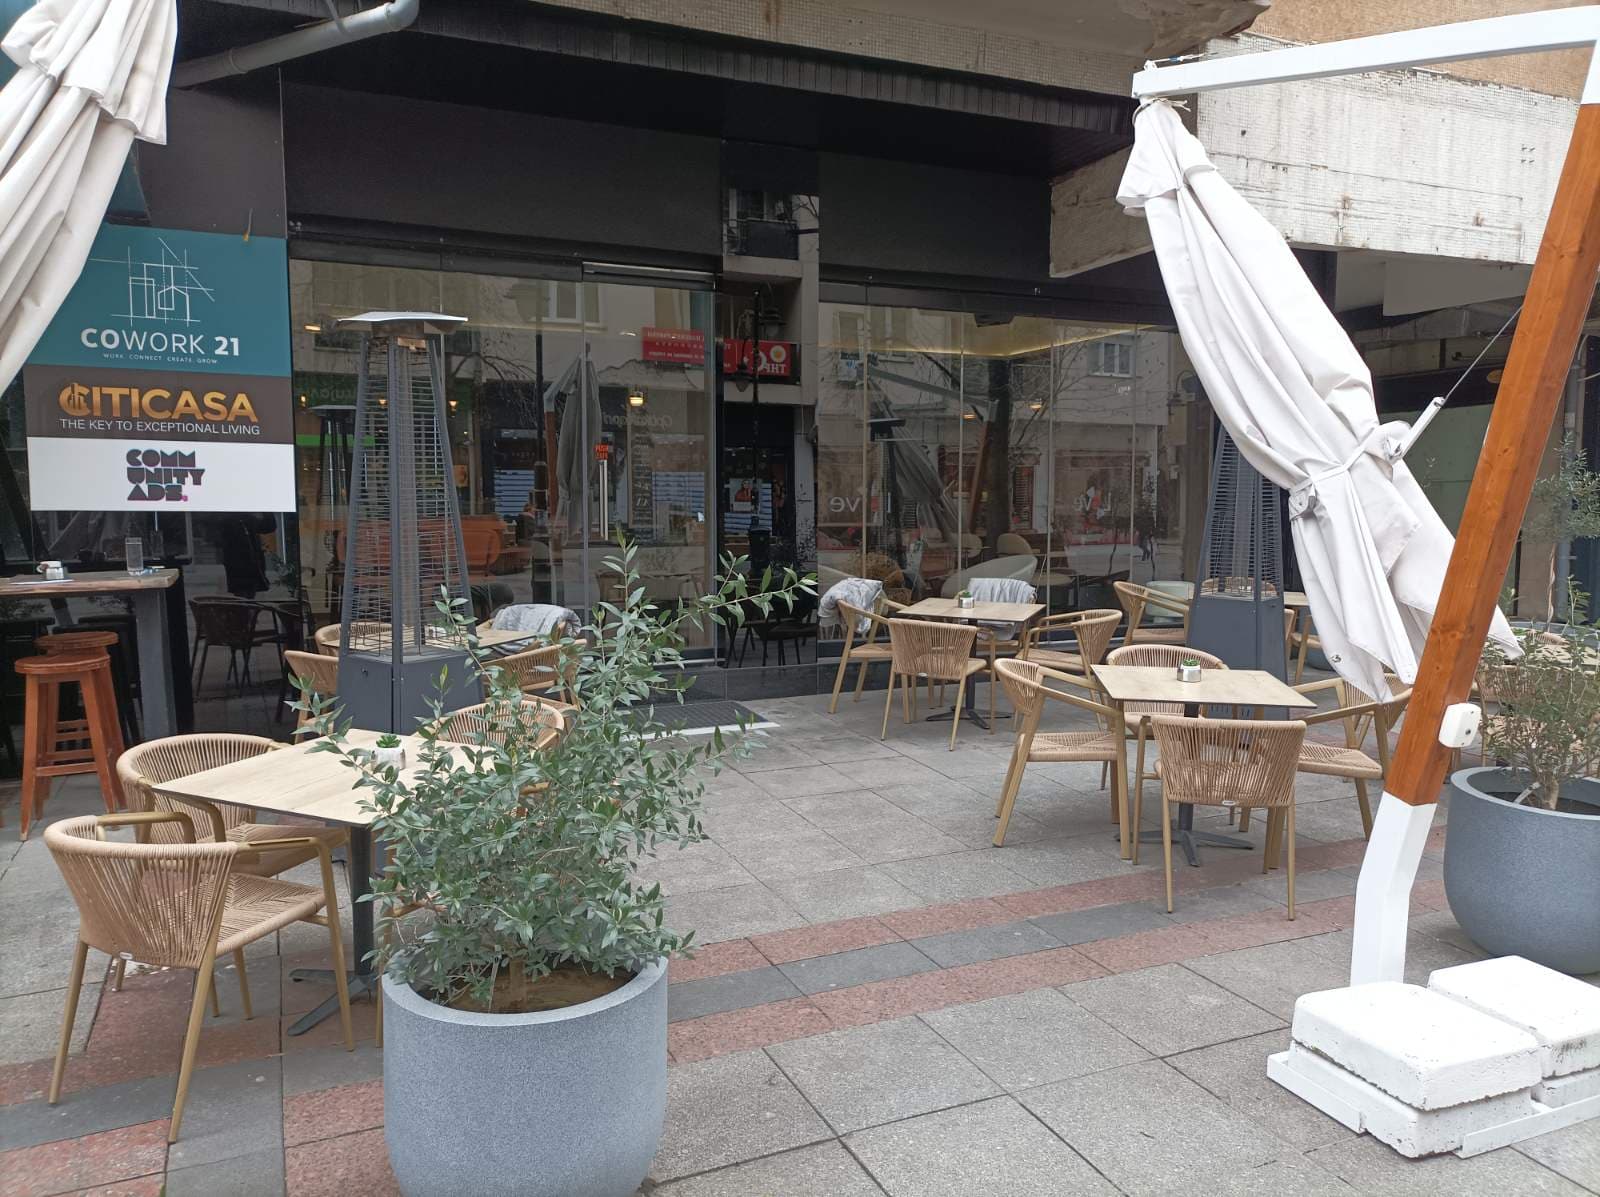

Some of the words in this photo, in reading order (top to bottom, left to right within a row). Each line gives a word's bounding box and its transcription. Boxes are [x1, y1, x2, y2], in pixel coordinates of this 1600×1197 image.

[81, 327, 205, 355] COWORK
[214, 336, 240, 356] 21
[58, 382, 259, 423] CITICASA
[59, 418, 86, 430] THE
[89, 420, 112, 431] KEY
[115, 420, 132, 431] TO
[136, 421, 219, 434] EXCEPTIONAL
[221, 424, 261, 435] LIVING
[126, 449, 196, 468] COMM
[127, 467, 205, 485] UNITY
